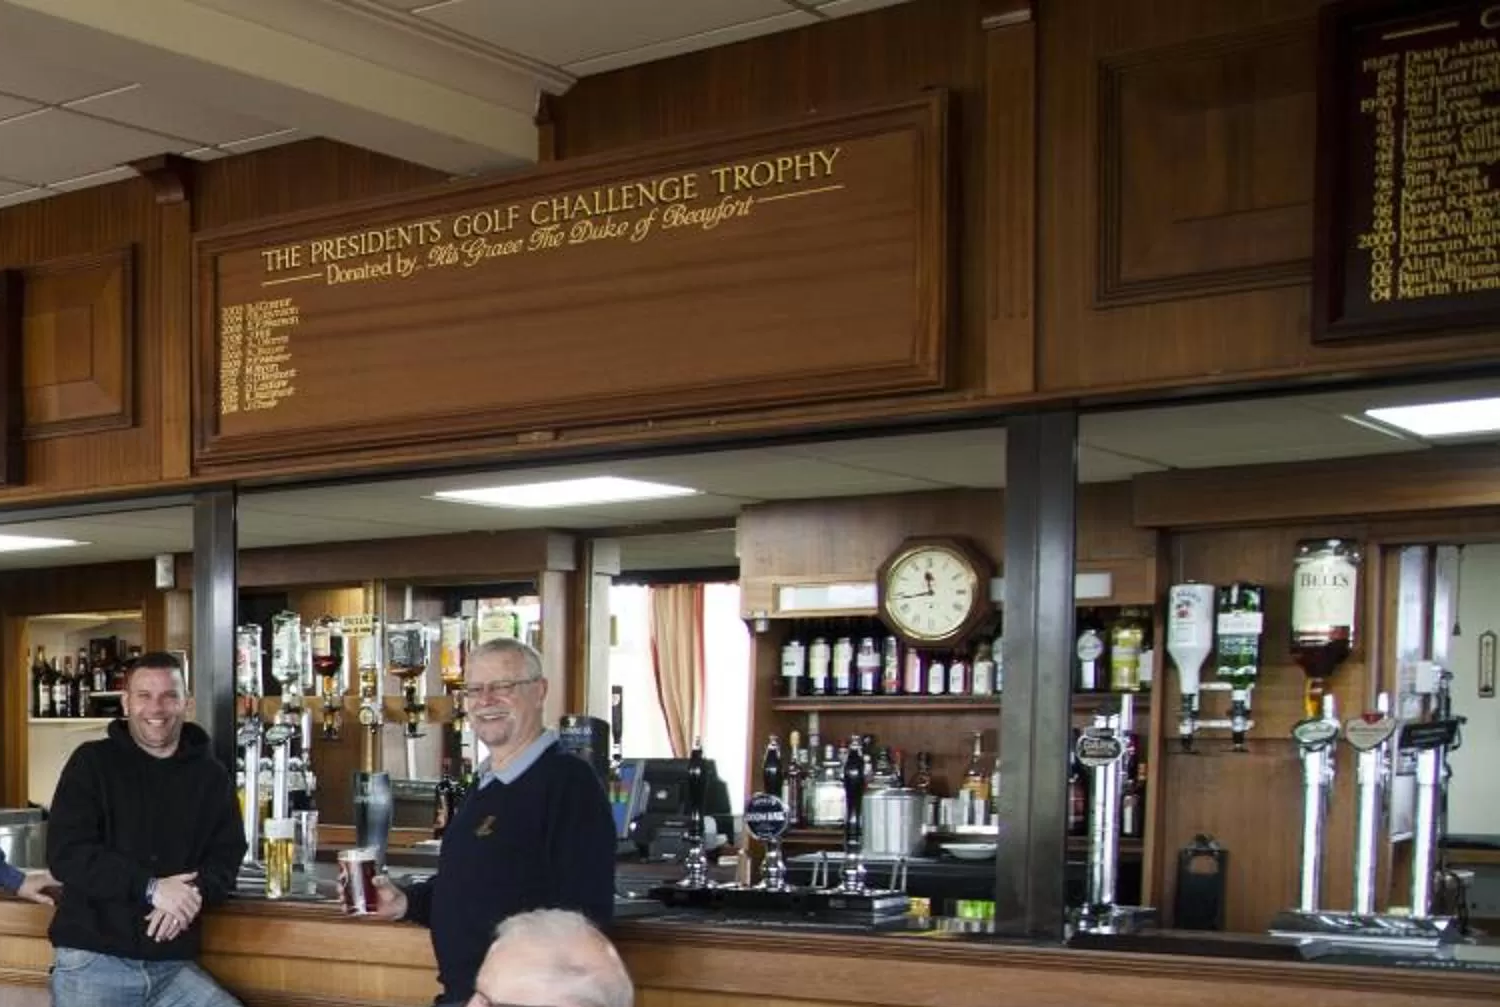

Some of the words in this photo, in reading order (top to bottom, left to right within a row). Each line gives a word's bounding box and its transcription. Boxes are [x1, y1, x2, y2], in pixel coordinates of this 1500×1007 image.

[262, 246, 300, 271] THE
[453, 205, 520, 238] GOLF
[531, 172, 699, 225] CHALLENGE
[712, 148, 840, 193] TROPHY
[327, 254, 392, 285] Donated
[461, 238, 523, 267] Grace
[528, 223, 565, 251] The
[569, 216, 628, 244] Duke
[631, 207, 659, 242] of
[661, 195, 754, 230] Beaufort
